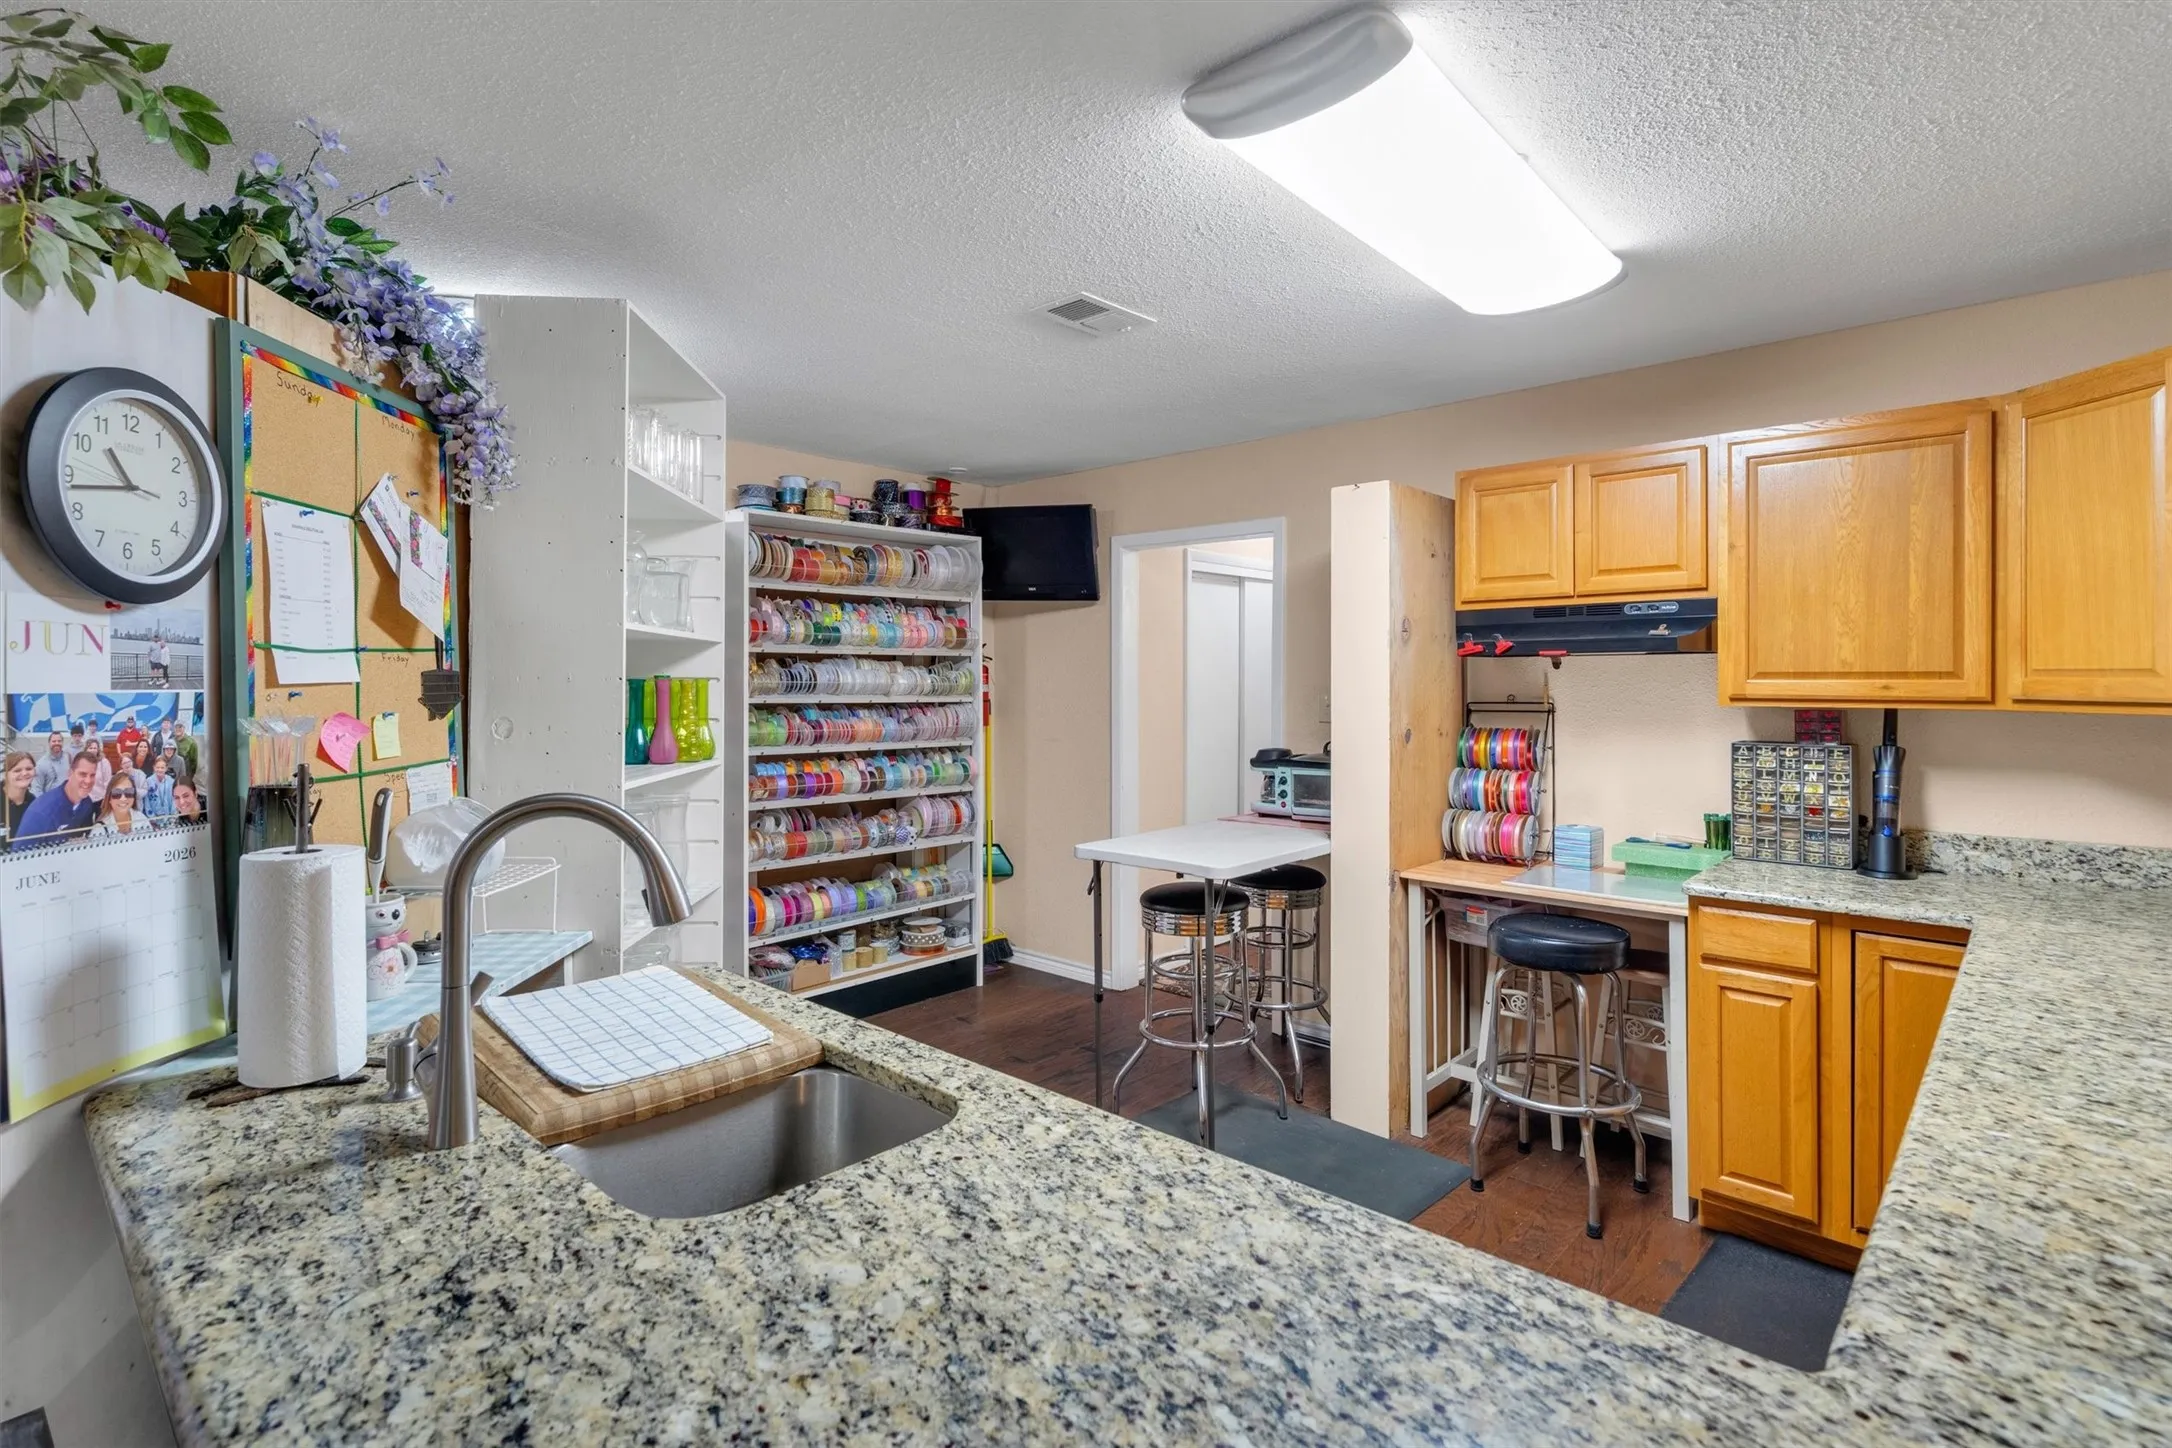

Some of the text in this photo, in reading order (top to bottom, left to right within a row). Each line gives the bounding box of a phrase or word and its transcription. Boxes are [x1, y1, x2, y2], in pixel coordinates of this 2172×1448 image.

[277, 371, 321, 407] Sunday
[93, 415, 108, 435] 11
[122, 413, 140, 434] 12
[381, 415, 415, 441] Monday
[73, 432, 92, 453] 10
[155, 432, 161, 448] 1
[64, 464, 74, 484] 9
[171, 456, 181, 474] 2
[178, 490, 188, 508] 3
[71, 502, 84, 521] 8
[170, 520, 180, 537] 4
[94, 529, 105, 548] 7
[151, 538, 161, 556] 5
[122, 542, 133, 560] 6
[9, 620, 107, 656] JUN
[381, 651, 410, 668] Friday
[1739, 746, 1748, 756] A
[164, 846, 197, 863] 2026
[15, 870, 61, 892] JUNE
